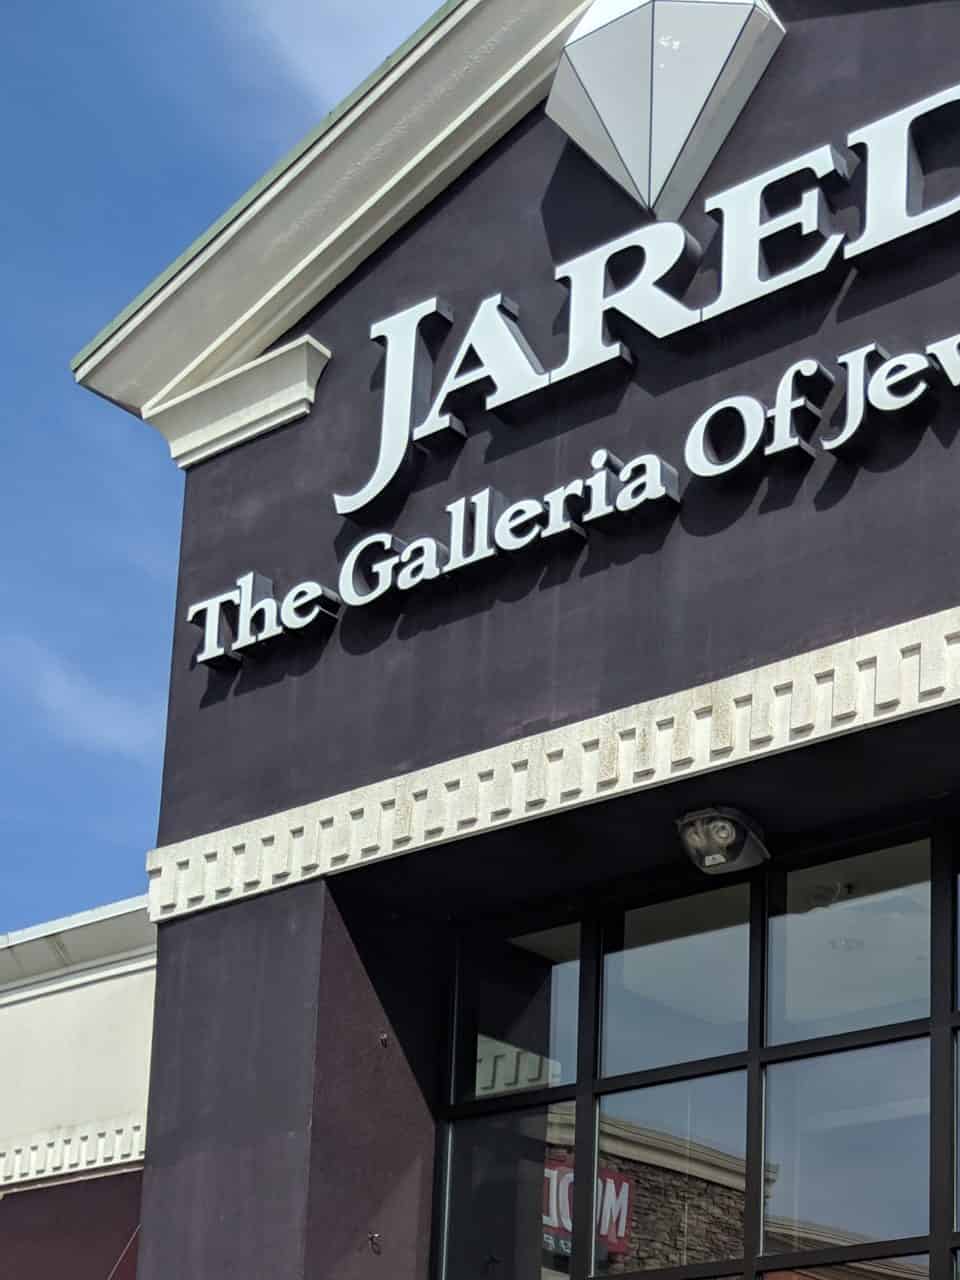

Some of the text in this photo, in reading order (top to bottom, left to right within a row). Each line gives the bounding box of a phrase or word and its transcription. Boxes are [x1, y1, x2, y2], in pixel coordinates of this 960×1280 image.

[188, 571, 323, 664] The
[338, 450, 667, 607] Galleria
[685, 359, 818, 478] Of
